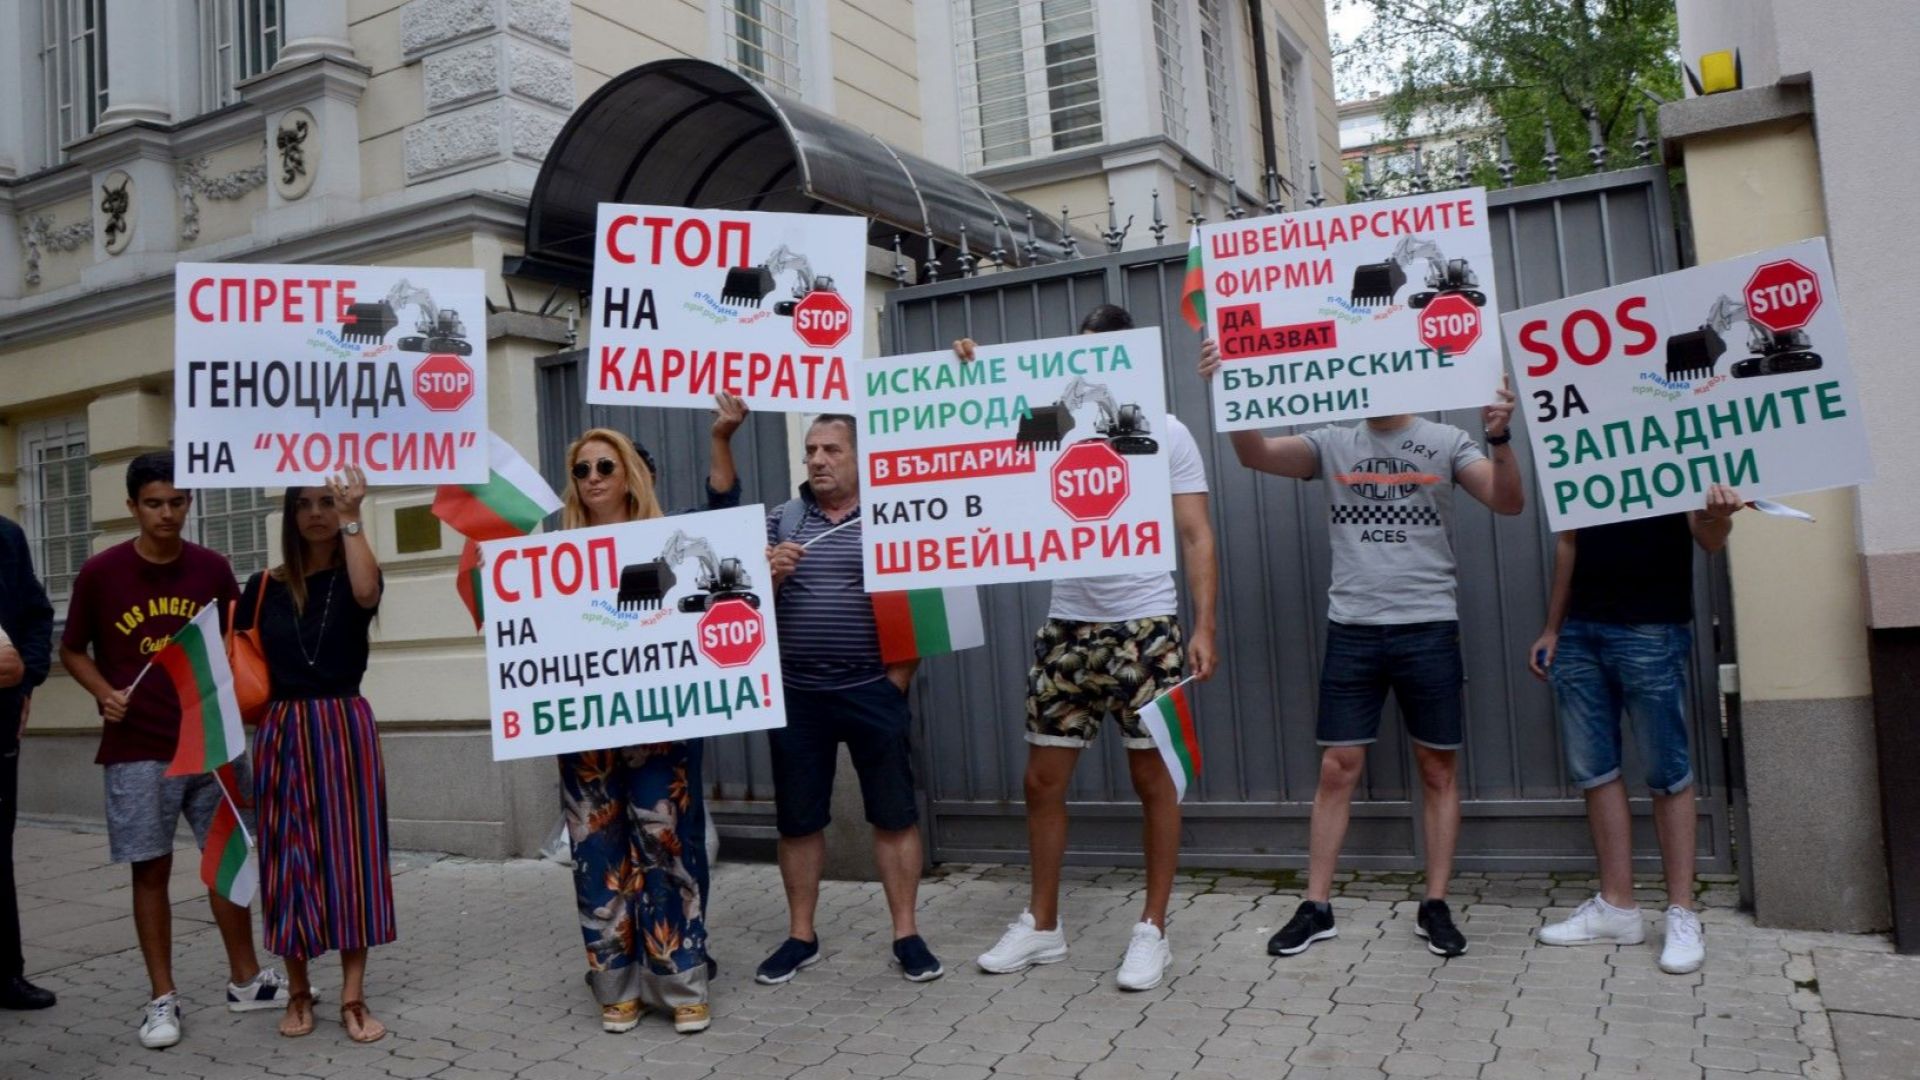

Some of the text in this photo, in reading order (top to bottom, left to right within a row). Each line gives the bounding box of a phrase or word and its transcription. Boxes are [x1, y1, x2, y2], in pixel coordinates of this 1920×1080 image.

[606, 215, 751, 269] СТОП
[1212, 200, 1475, 259] ШВЕЙЦАРСКИТЕ
[1215, 259, 1334, 298] ФИРМИ
[1751, 279, 1813, 313] STOP
[188, 277, 358, 324] СПРЕТЕ
[603, 287, 659, 330] НА
[798, 309, 848, 331] STOP
[1222, 309, 1255, 332] ДА
[1424, 312, 1476, 339] STOP
[1519, 296, 1658, 378] SOS
[1224, 326, 1332, 355] СПАЗВАТ
[418, 373, 469, 393] STOP
[599, 347, 850, 400] КАРИЕРАТА
[867, 344, 1132, 397] ИСКАМЕ ЧИСТА
[1223, 345, 1455, 391] БЪЛГАРСКИТЕ
[188, 361, 407, 419] ГЕНОЦИДА
[1225, 387, 1369, 422] ЗАКОНИ!
[1533, 384, 1590, 422] ЗА
[869, 395, 1033, 435] ПРИРОДА
[1543, 381, 1847, 469] ЗАПАДНИТЕ
[188, 441, 235, 473] НА
[875, 446, 1031, 479] В БЪЛГАРИЯ
[1058, 466, 1123, 498] STOP
[1553, 448, 1760, 515] РОДОПИ
[873, 495, 983, 525] КАТО В
[875, 521, 1161, 575] ШВЕЙЦАРИЯ
[1361, 529, 1408, 543] ACES
[492, 537, 619, 602] СТОП
[115, 597, 204, 636] LOS ANGEL
[497, 617, 537, 647] НА
[704, 619, 759, 648] STOP
[500, 639, 698, 690] КОНЦЕСИЯТА
[503, 673, 772, 739] В БЕЛАЩИЦА!
